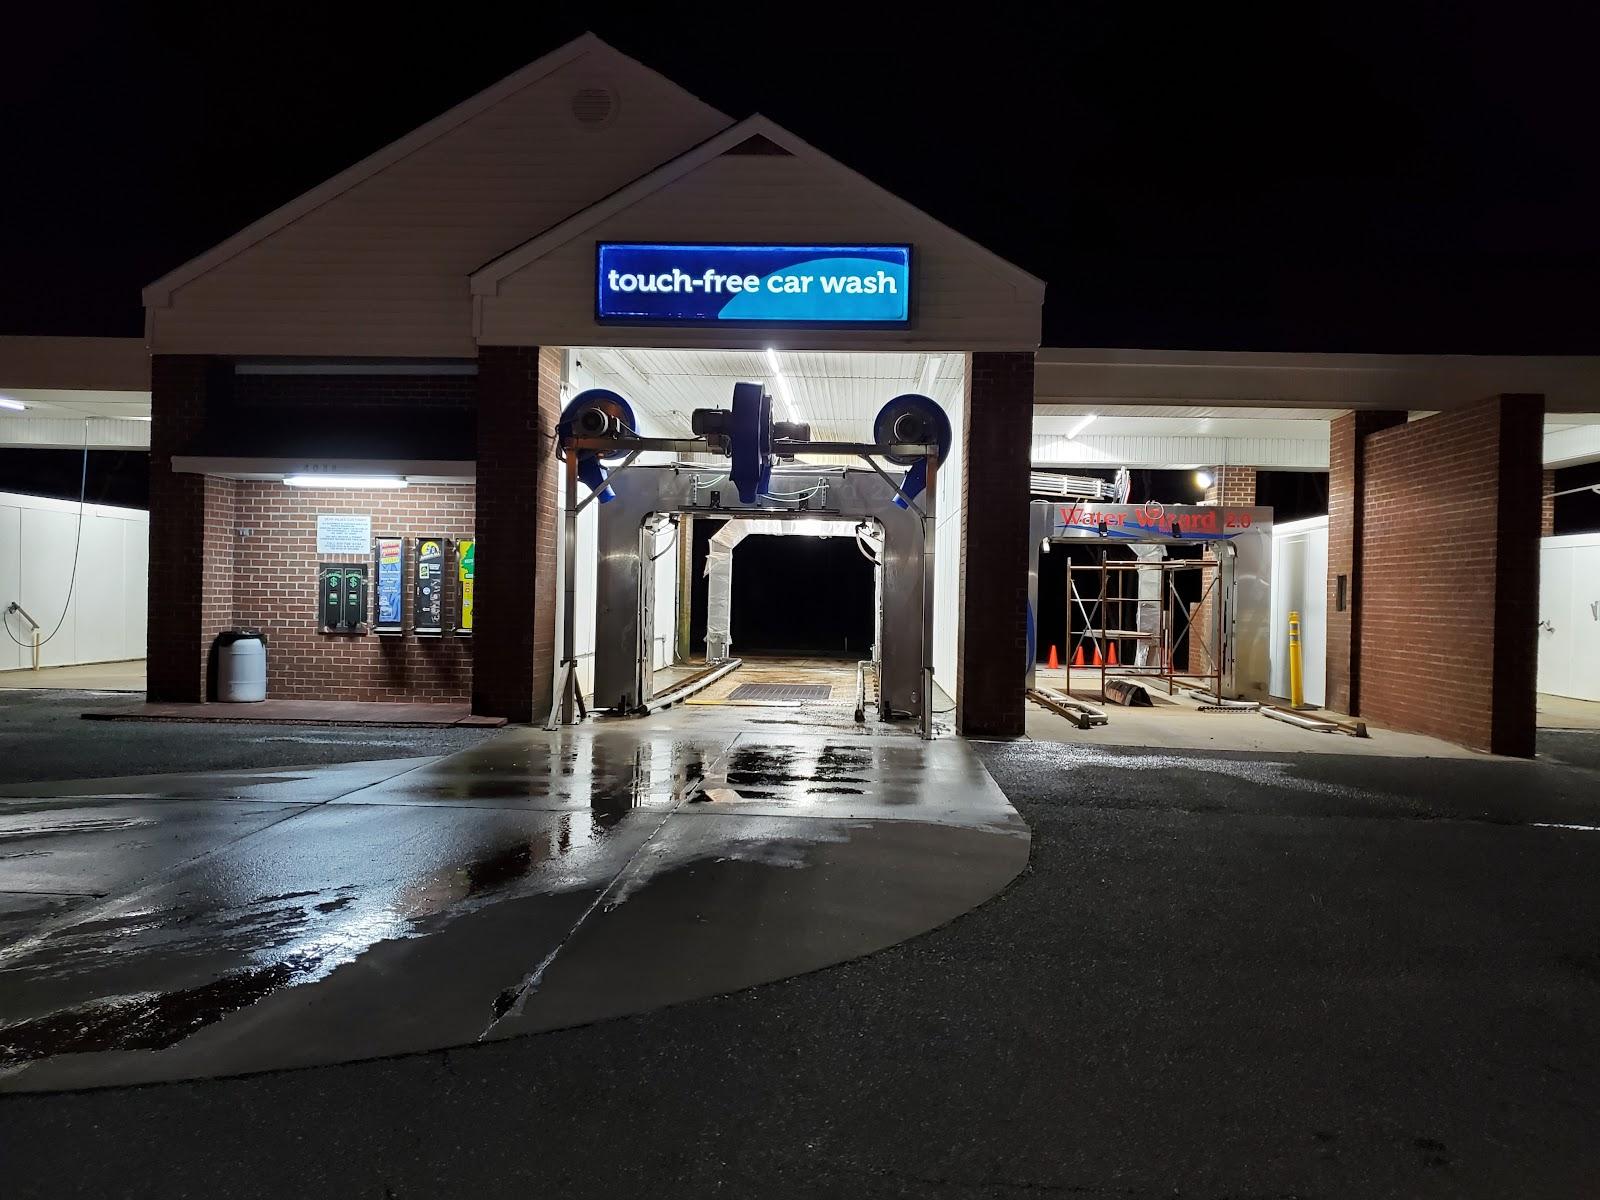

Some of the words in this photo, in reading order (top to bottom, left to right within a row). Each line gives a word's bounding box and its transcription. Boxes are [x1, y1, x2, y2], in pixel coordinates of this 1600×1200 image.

[608, 269, 760, 293] touch-free
[767, 274, 817, 293] car
[820, 271, 897, 294] wash
[1059, 508, 1127, 528] Water
[1135, 507, 1217, 529] Wizard
[1226, 512, 1252, 528] 2.0
